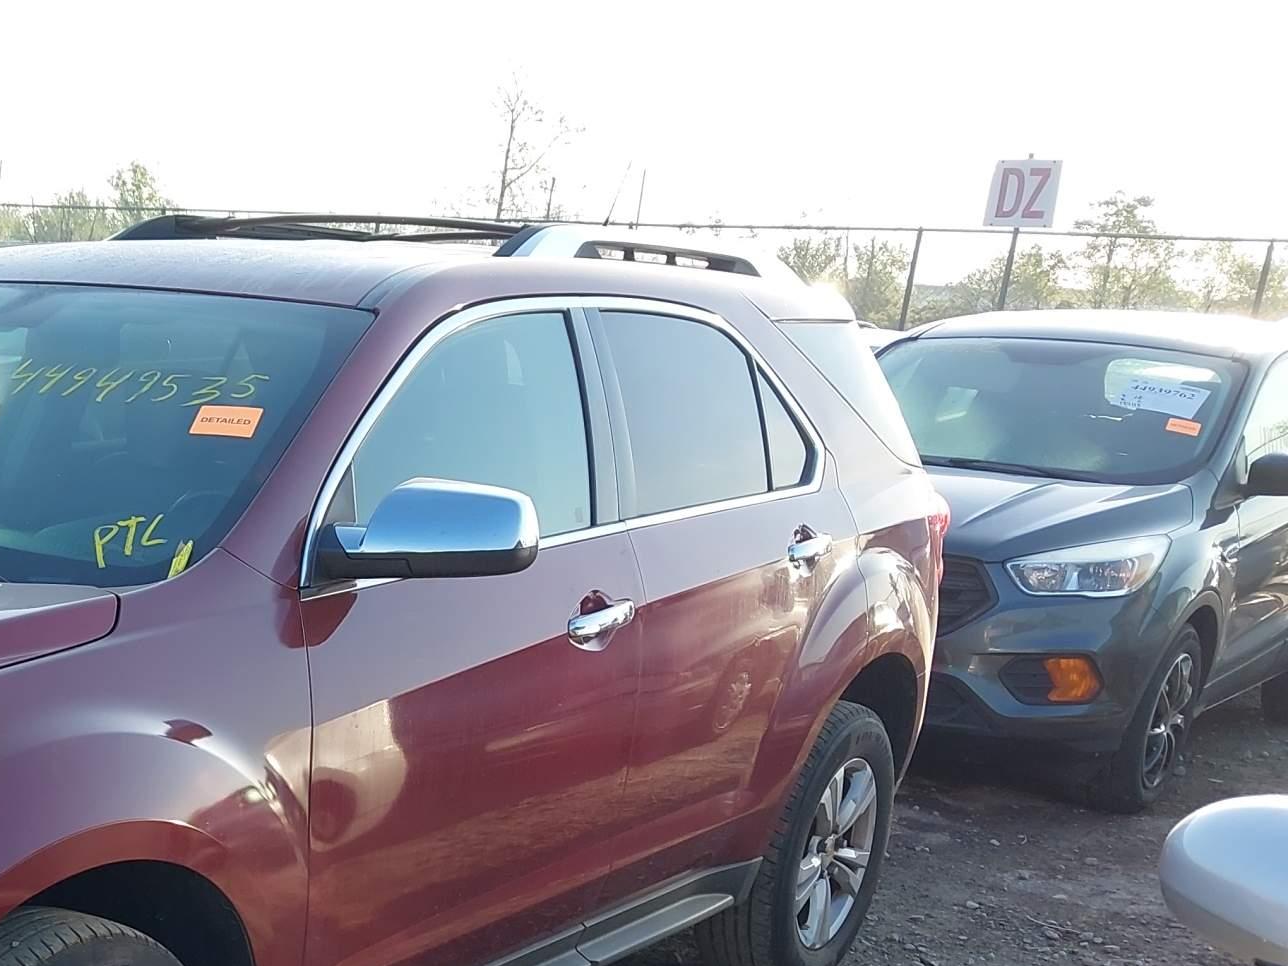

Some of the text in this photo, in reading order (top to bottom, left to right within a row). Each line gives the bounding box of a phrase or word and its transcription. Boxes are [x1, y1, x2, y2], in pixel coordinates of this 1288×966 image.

[994, 167, 1052, 218] DZ
[11, 358, 270, 407] 44949535
[199, 415, 252, 427] DETAILED
[93, 513, 168, 569] PTL
